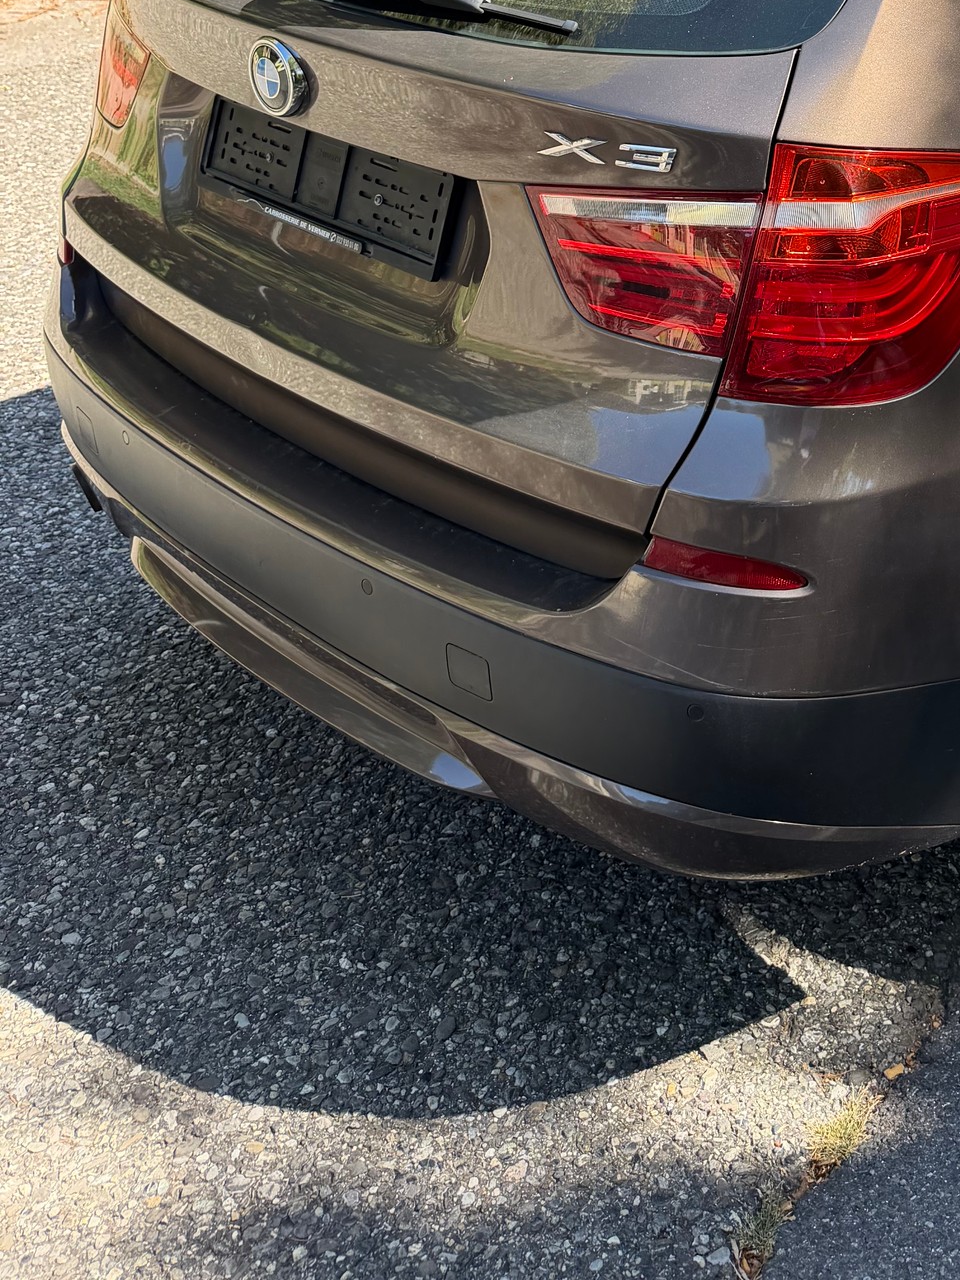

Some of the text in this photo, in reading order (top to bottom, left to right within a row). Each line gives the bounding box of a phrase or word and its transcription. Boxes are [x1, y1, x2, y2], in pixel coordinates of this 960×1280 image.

[536, 131, 677, 173] X3
[264, 206, 300, 226] CARROSSERIE
[300, 220, 308, 230] DE
[308, 223, 331, 239] VERNIER
